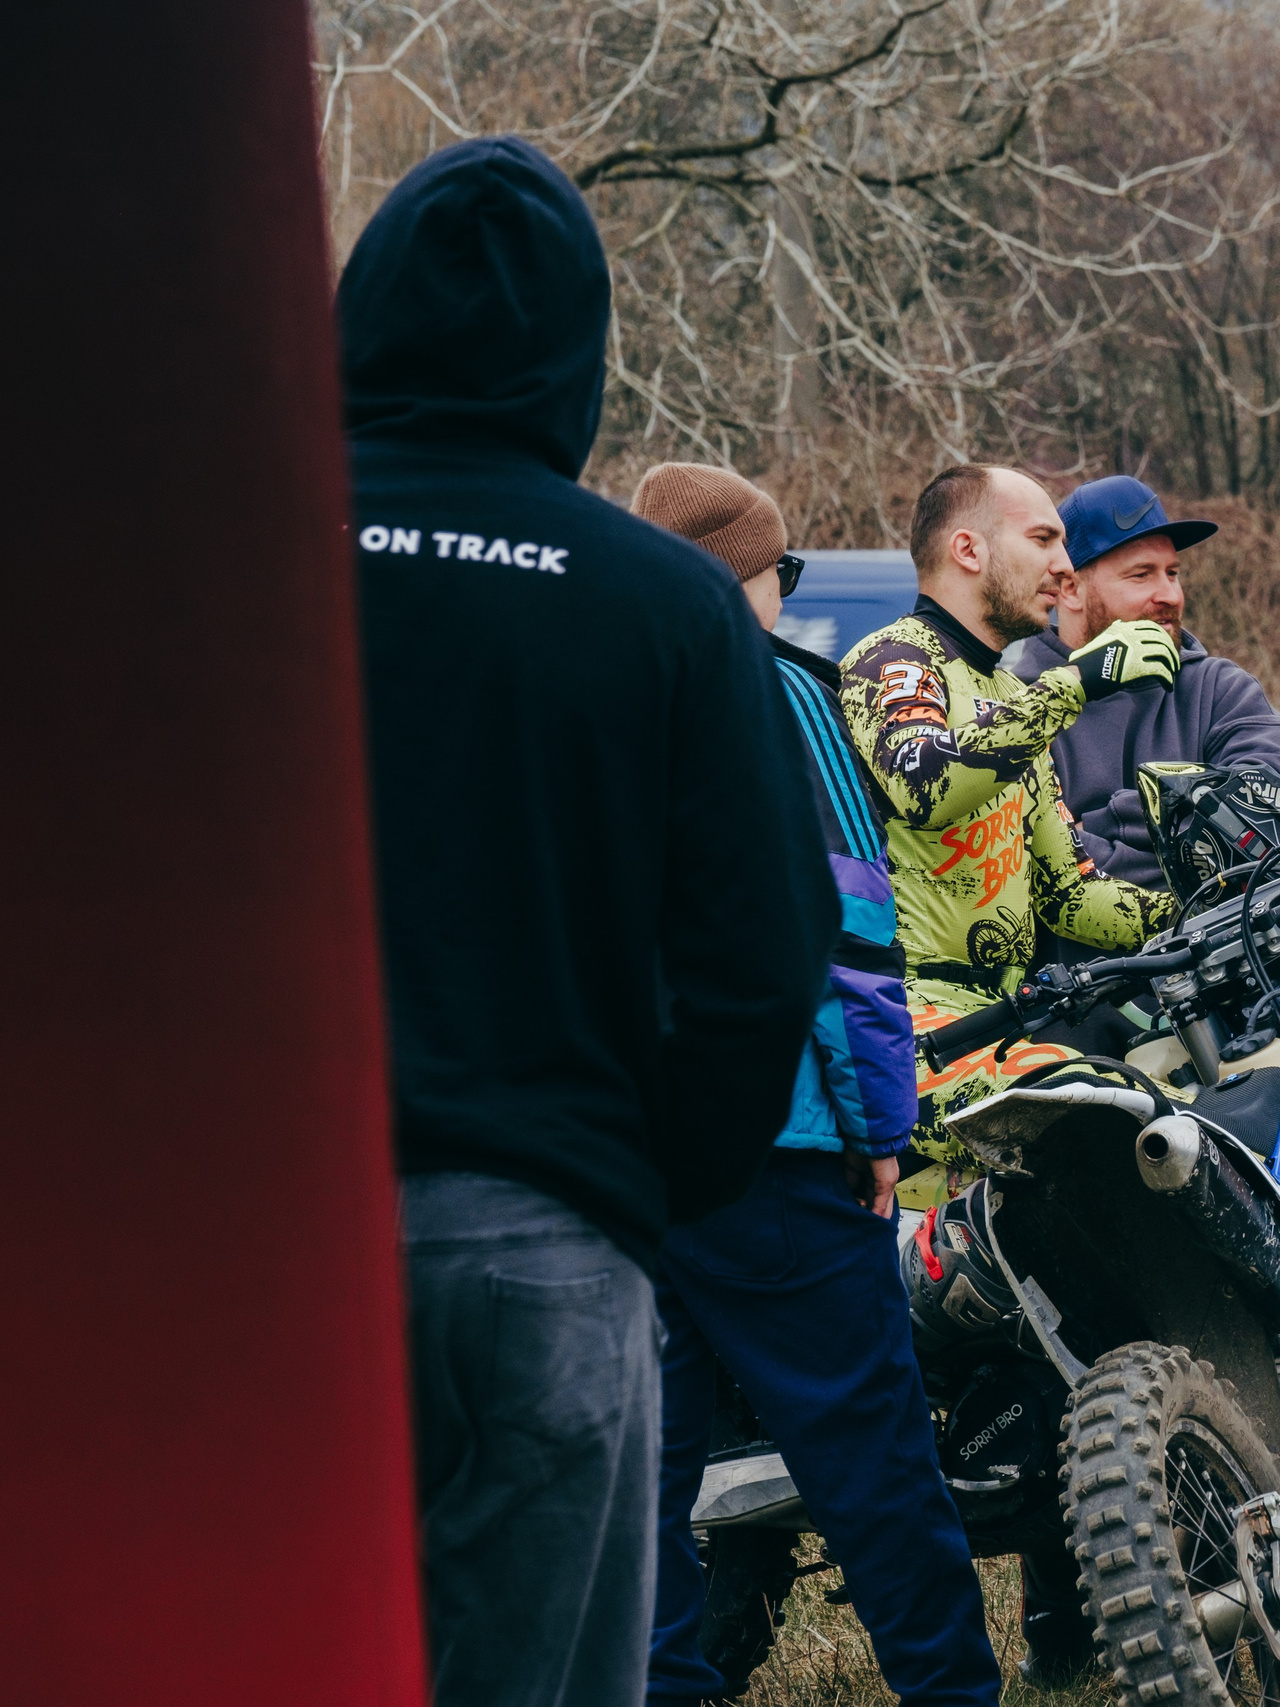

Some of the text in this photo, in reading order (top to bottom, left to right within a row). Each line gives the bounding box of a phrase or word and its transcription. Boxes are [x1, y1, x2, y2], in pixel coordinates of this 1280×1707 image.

[359, 525, 569, 575] ON TRACK
[931, 786, 1024, 876] SORRY
[971, 834, 1024, 910] BRO
[1191, 840, 1214, 882] Airo
[960, 1403, 1023, 1461] SORRY BRO
